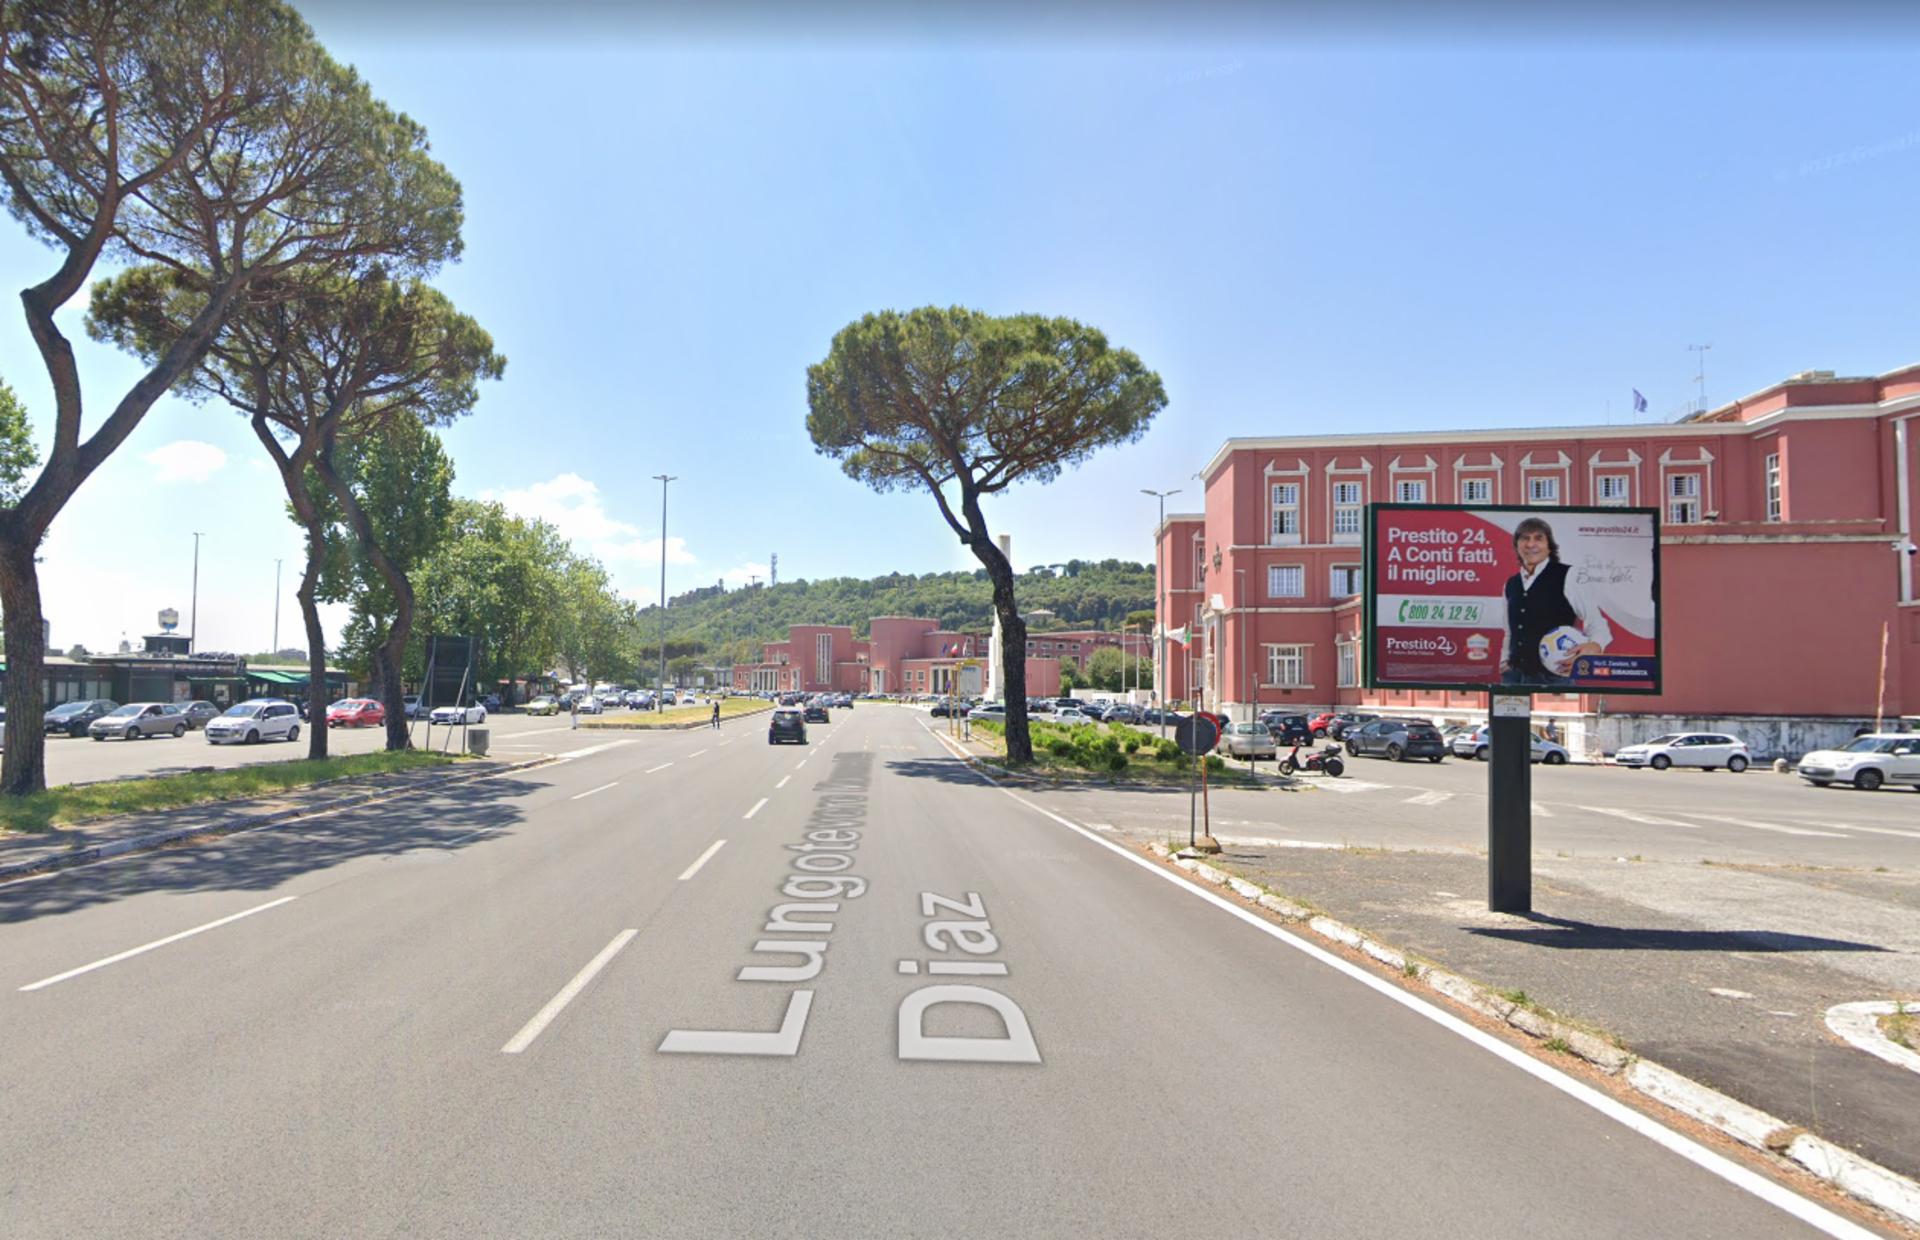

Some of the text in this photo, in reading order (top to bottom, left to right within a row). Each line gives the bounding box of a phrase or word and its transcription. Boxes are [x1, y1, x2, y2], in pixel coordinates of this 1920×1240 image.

[1387, 527, 1491, 545] Prestito 24.
[1387, 546, 1498, 567] A Conti fatti,
[1387, 564, 1481, 585] il migliore.
[1408, 605, 1479, 621] 800 24 12 24
